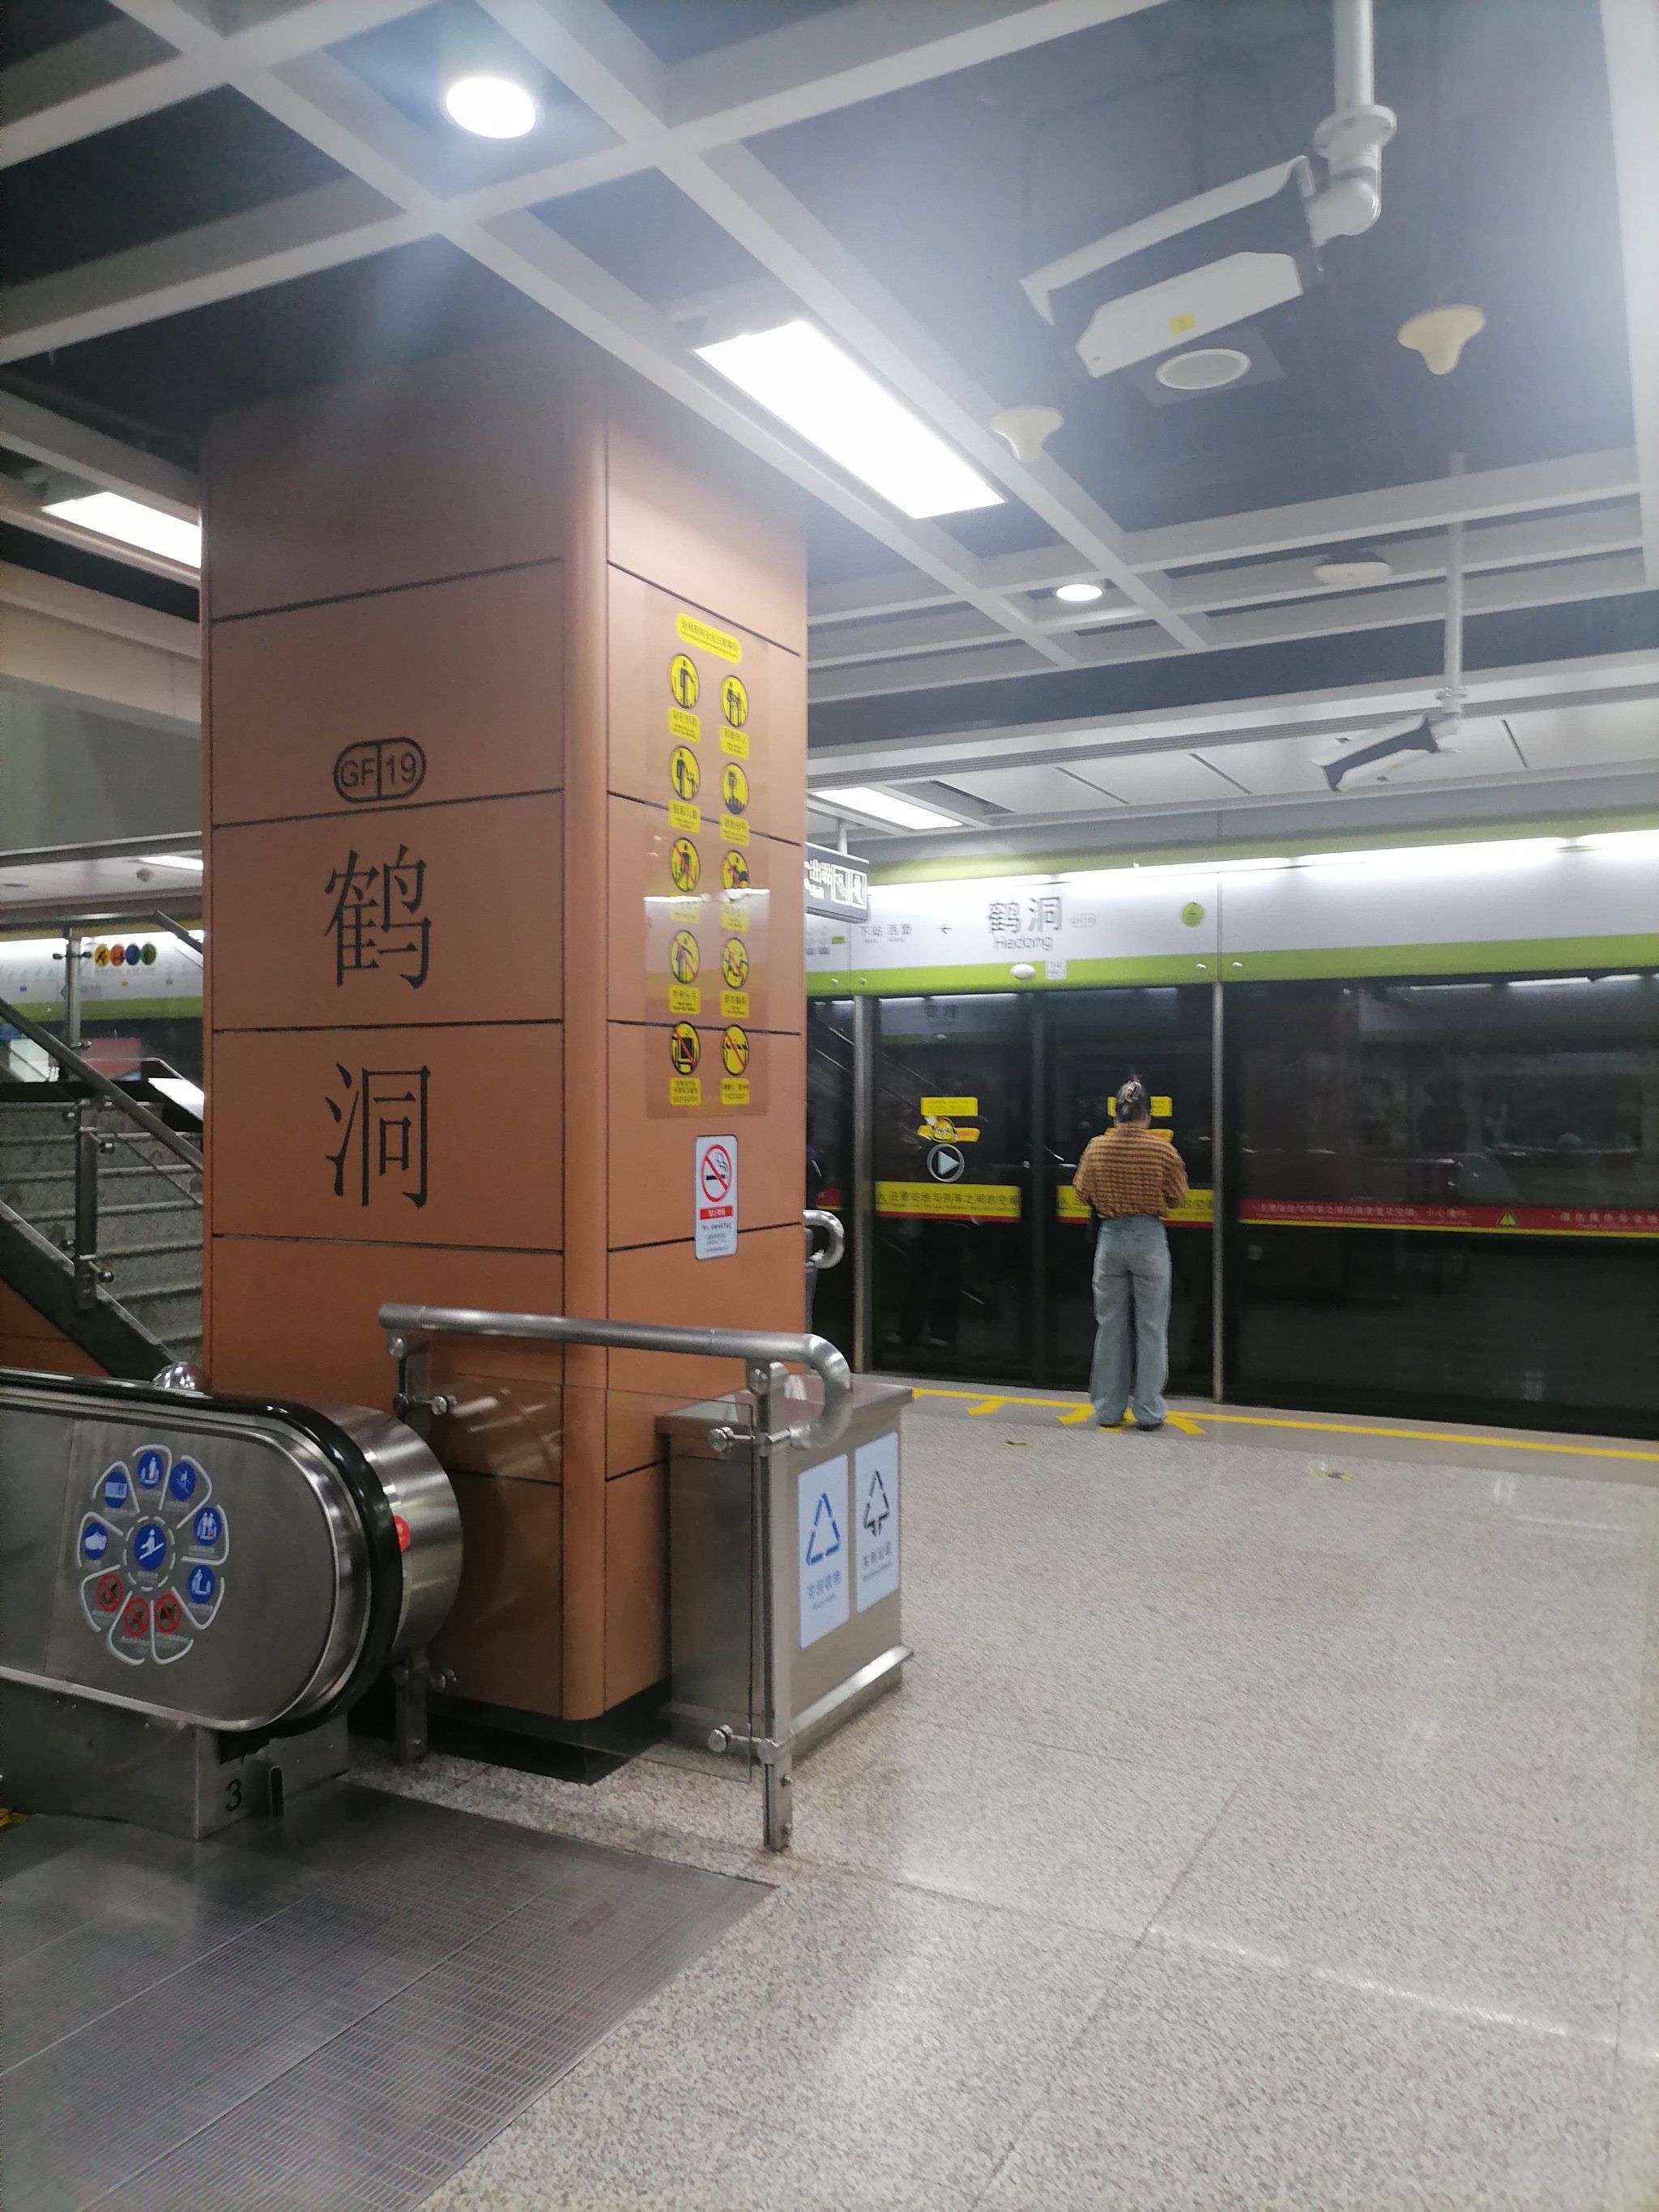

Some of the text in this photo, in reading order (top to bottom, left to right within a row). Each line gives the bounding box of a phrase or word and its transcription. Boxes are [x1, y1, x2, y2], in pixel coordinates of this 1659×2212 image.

[340, 752, 416, 787] GF 19
[987, 896, 1062, 934] 鹤洞
[993, 936, 1053, 951] Hedong
[325, 844, 432, 1209] 鹤洞
[226, 1779, 242, 1811] 3
